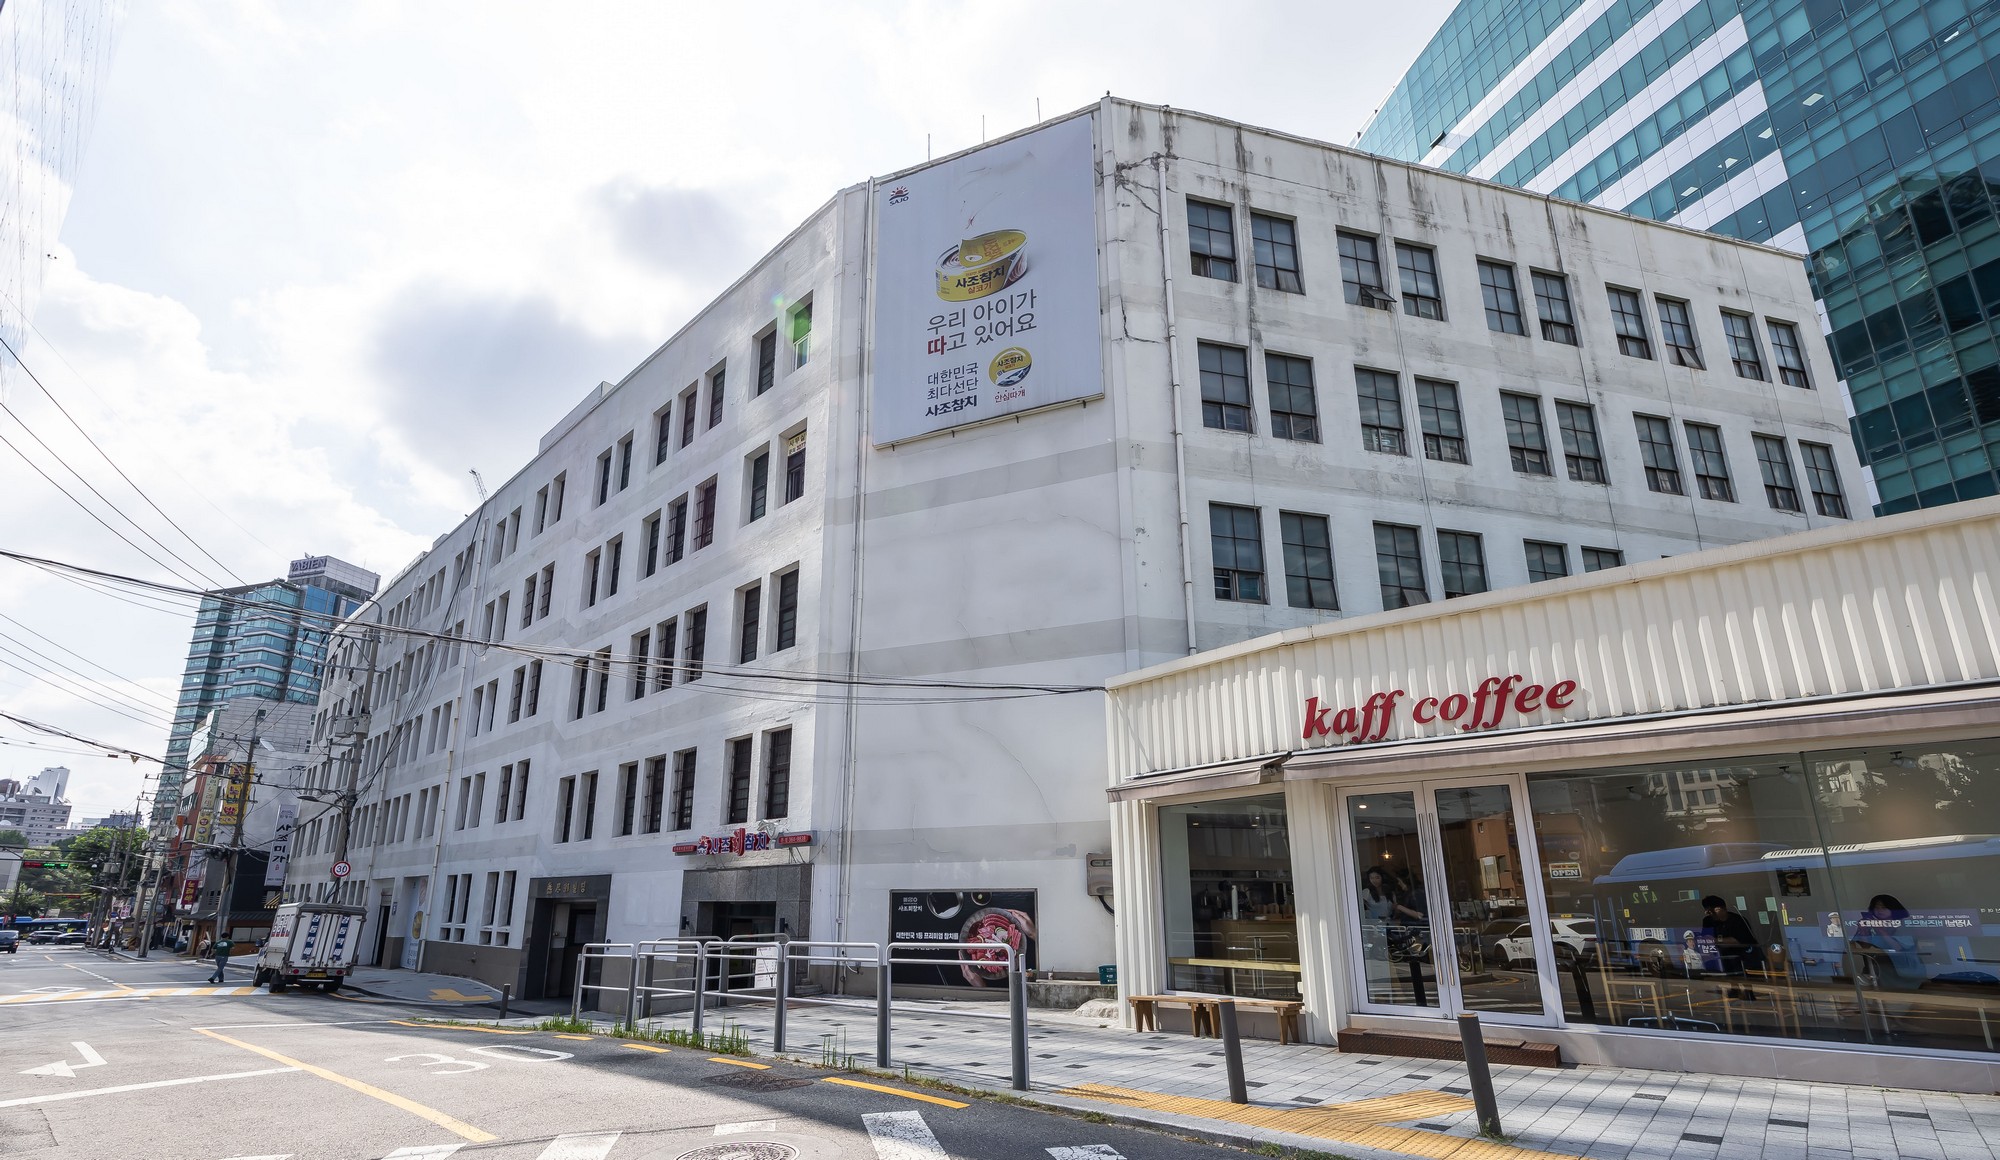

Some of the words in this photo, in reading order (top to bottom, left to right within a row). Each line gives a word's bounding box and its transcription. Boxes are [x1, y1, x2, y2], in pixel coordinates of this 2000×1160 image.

[890, 196, 909, 206] SAJO
[955, 265, 1005, 288] 사조참치
[927, 308, 966, 335] 우리
[973, 289, 1037, 320] 아이가
[927, 332, 967, 355] 따고
[974, 313, 1037, 345] 있어요
[997, 355, 1024, 367] 사조참치
[927, 362, 978, 385] 대한민국
[927, 377, 978, 400] 최다선단
[925, 395, 977, 417] 사조참치
[1302, 689, 1404, 743] kaff
[1412, 674, 1577, 731] coffee
[272, 824, 292, 863] 사조미가
[336, 865, 348, 873] 30
[1552, 869, 1579, 877] OPEN
[896, 931, 915, 939] 대한민국
[384, 1044, 575, 1075] 30
